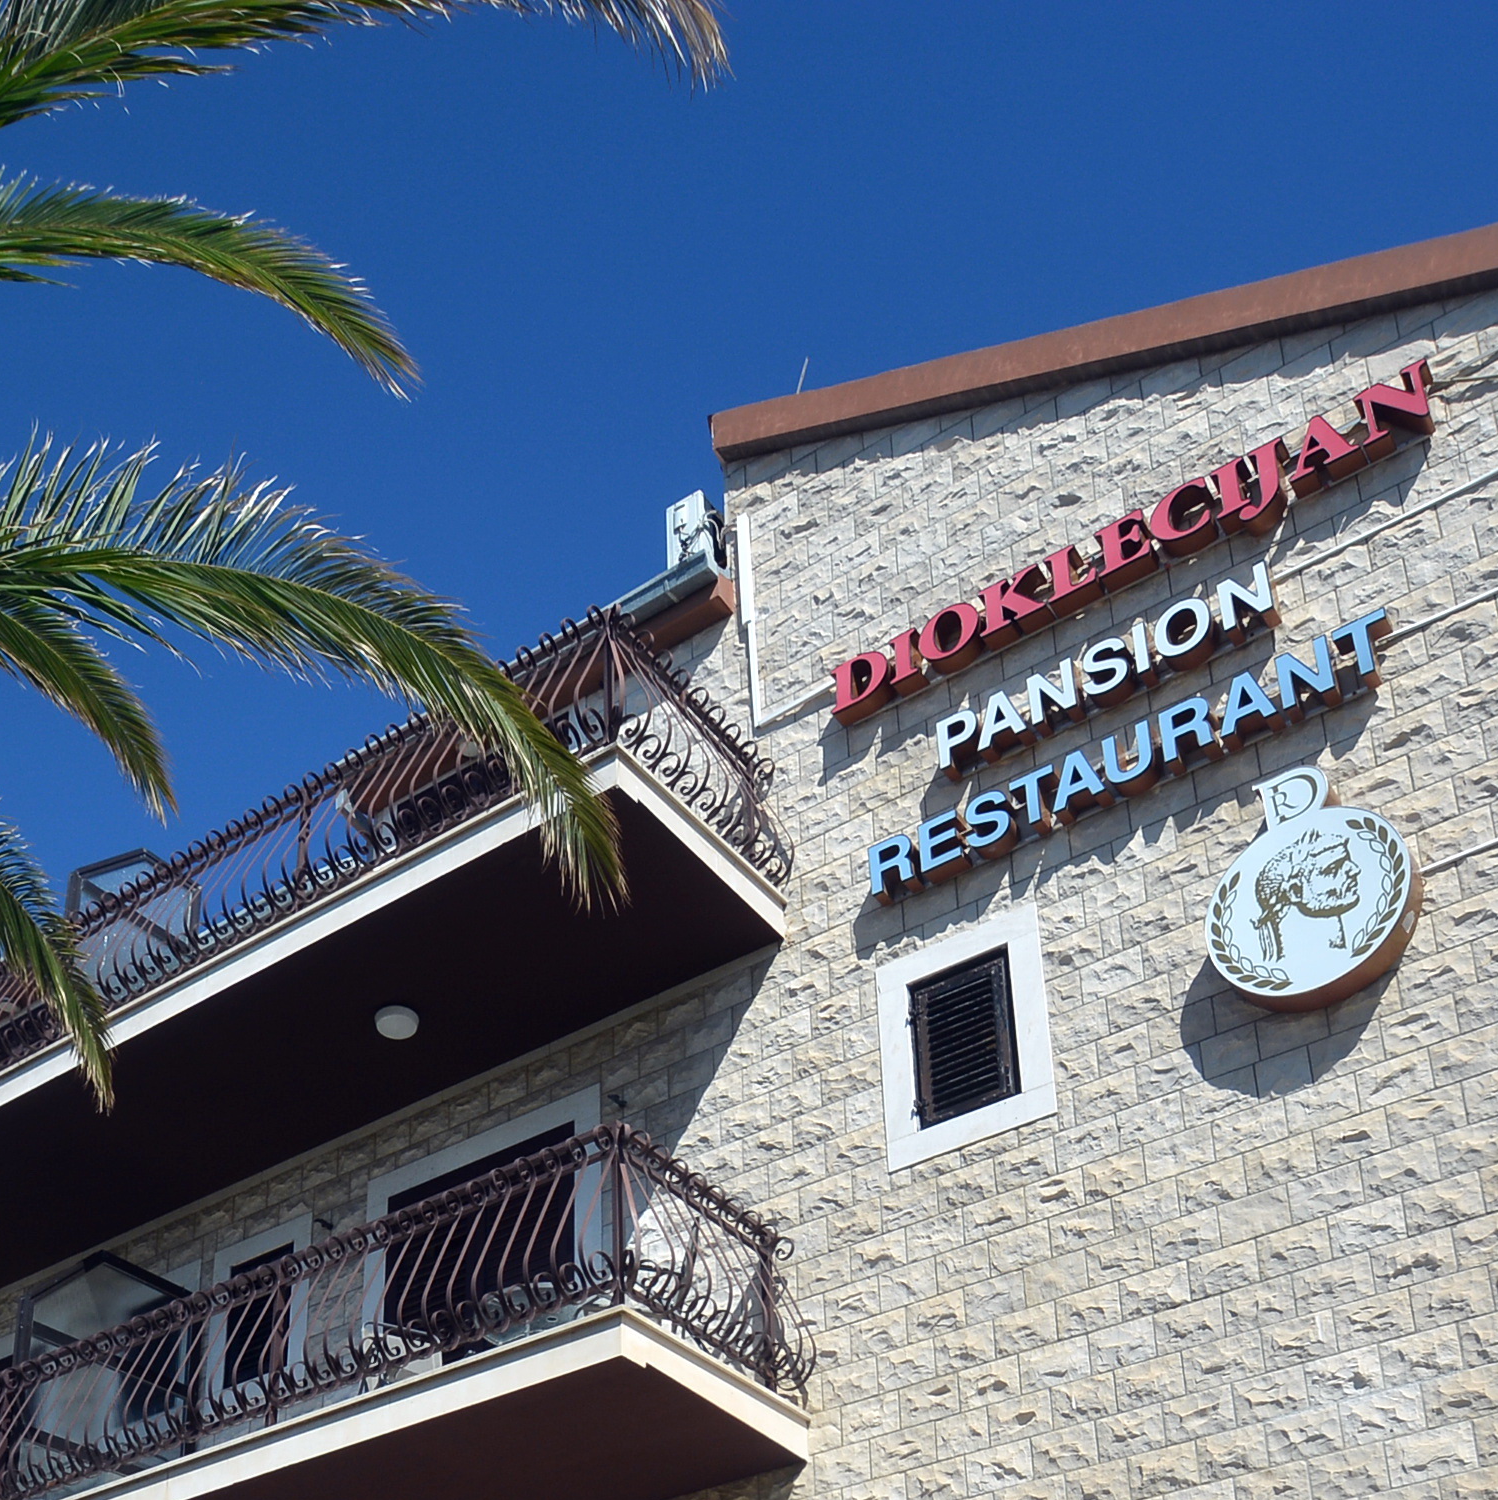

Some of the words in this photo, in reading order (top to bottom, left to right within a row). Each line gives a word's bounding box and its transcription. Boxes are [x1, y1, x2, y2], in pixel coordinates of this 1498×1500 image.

[831, 358, 1433, 716] DIOKLECIJAN
[936, 560, 1275, 769] PANSION
[868, 607, 1387, 897] RESTAURANT
